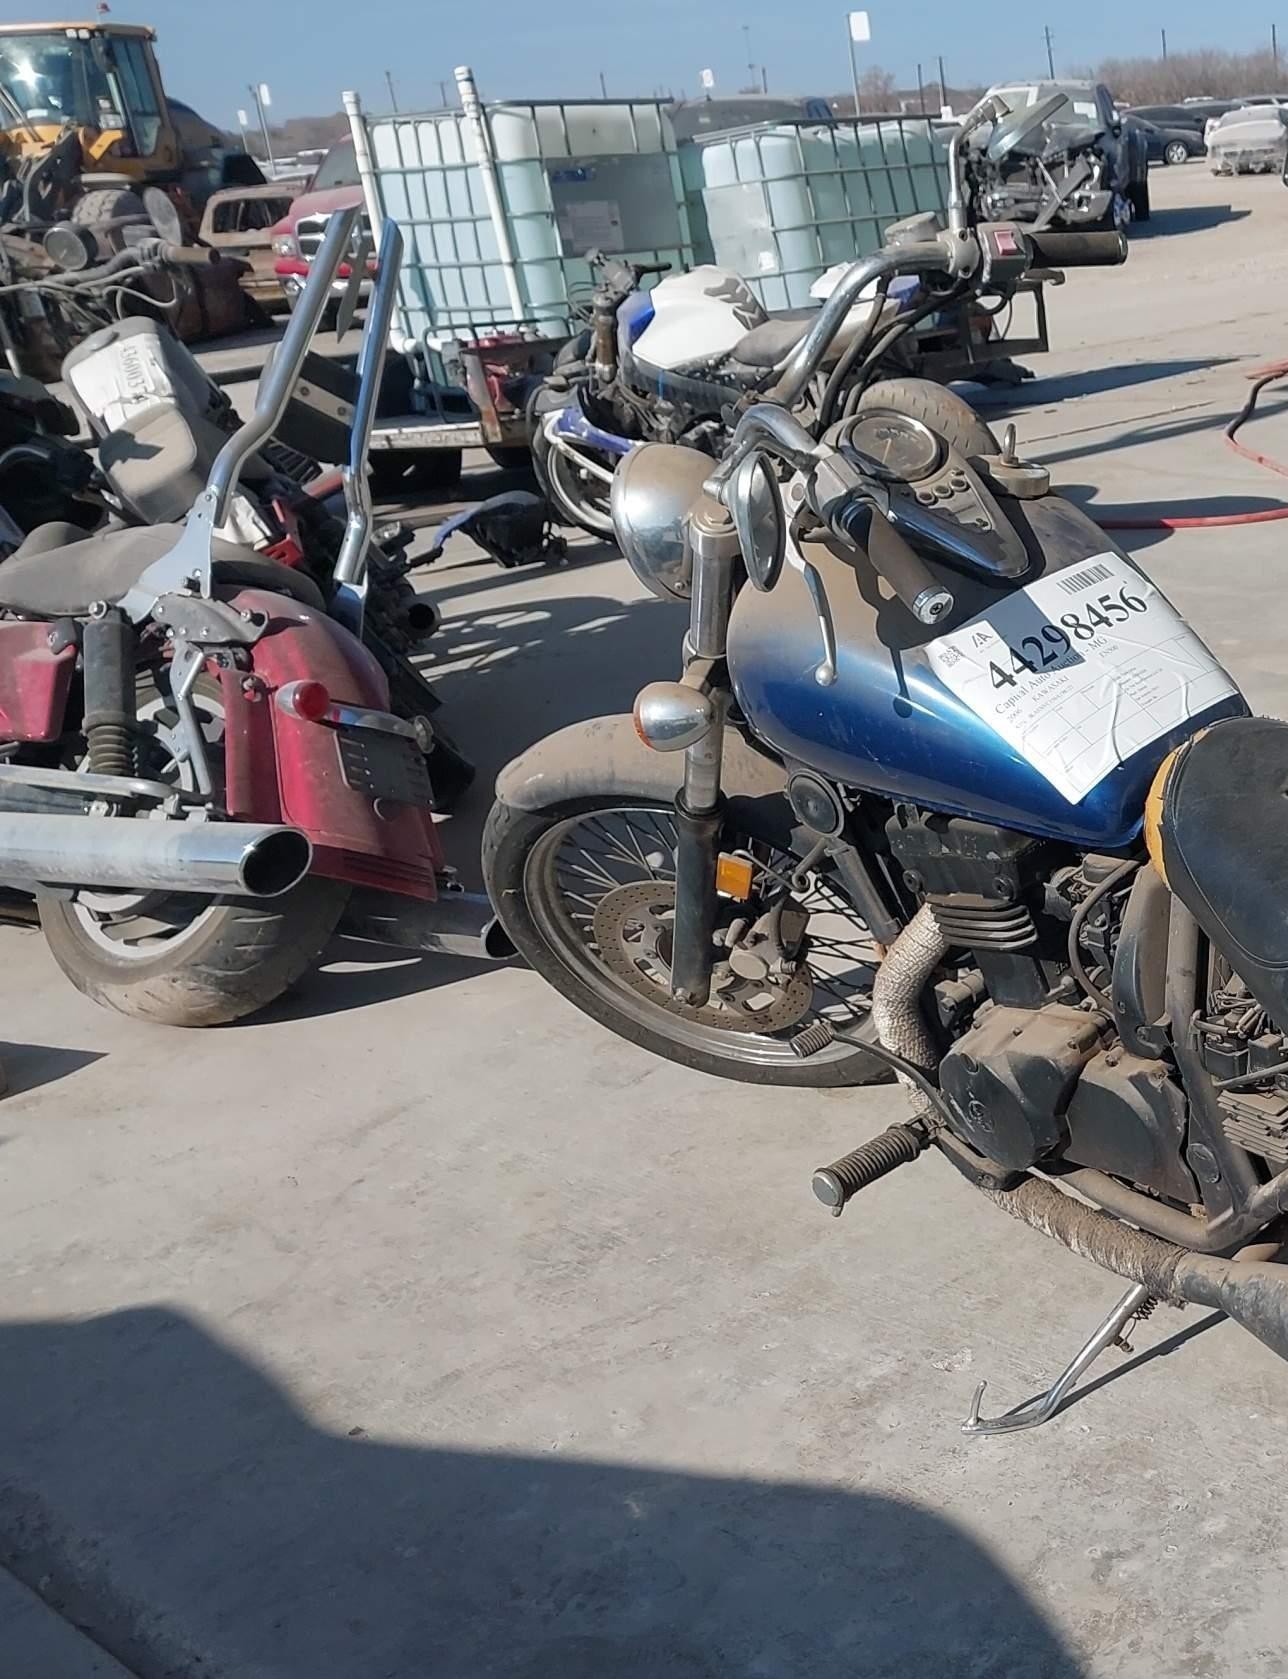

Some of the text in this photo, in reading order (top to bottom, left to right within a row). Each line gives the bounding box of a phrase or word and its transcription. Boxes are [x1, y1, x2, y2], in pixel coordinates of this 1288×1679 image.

[988, 580, 1148, 689] 44298456
[995, 686, 1030, 714] Capital
[1028, 672, 1052, 691] Auto
[1088, 636, 1108, 651] MG
[1032, 674, 1070, 703] KAWASAKI
